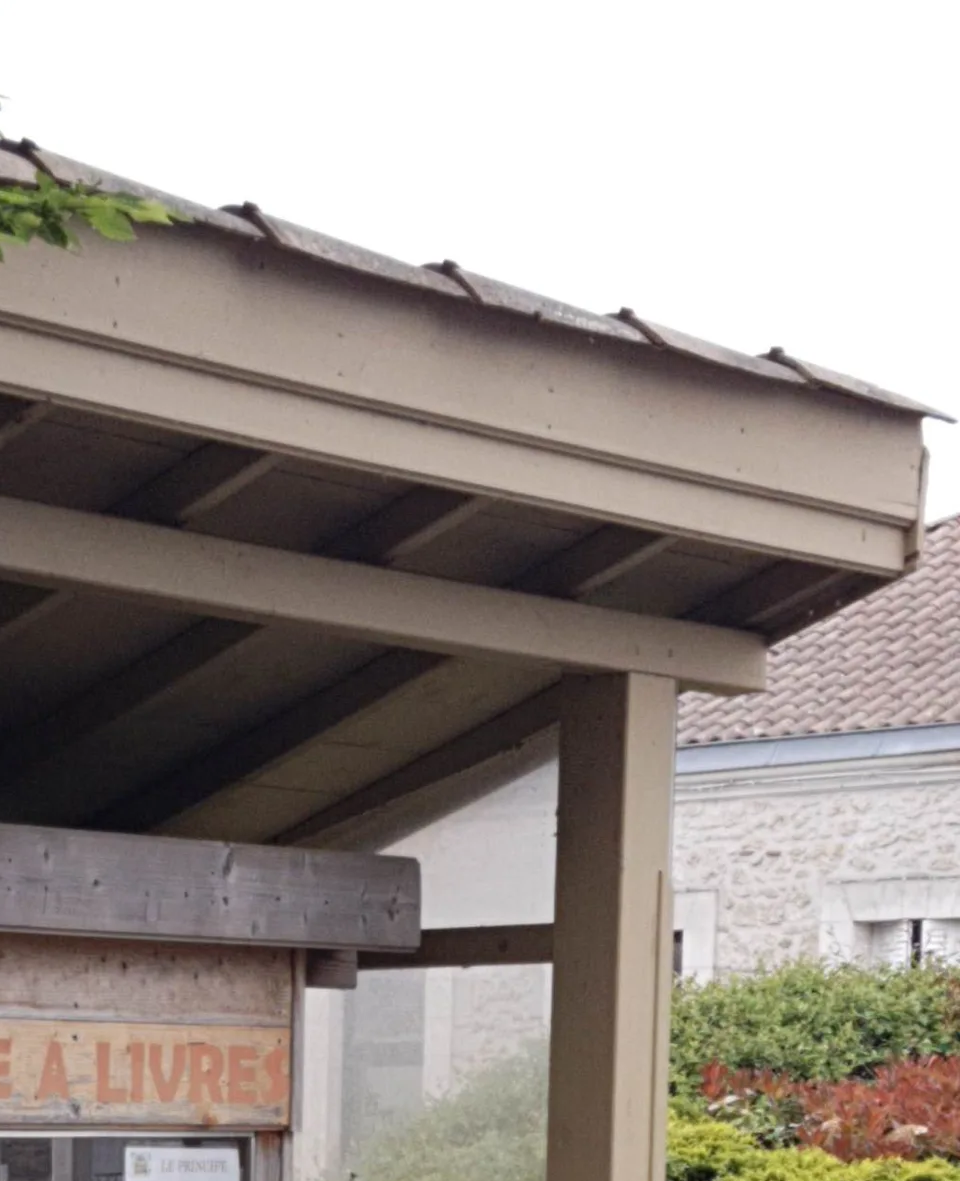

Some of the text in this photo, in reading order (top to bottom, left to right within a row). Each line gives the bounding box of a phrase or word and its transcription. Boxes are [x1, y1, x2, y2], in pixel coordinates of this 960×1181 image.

[36, 1040, 71, 1100] A
[96, 1042, 289, 1104] LIVRES
[160, 1159, 228, 1173] LE PRINCIPE
